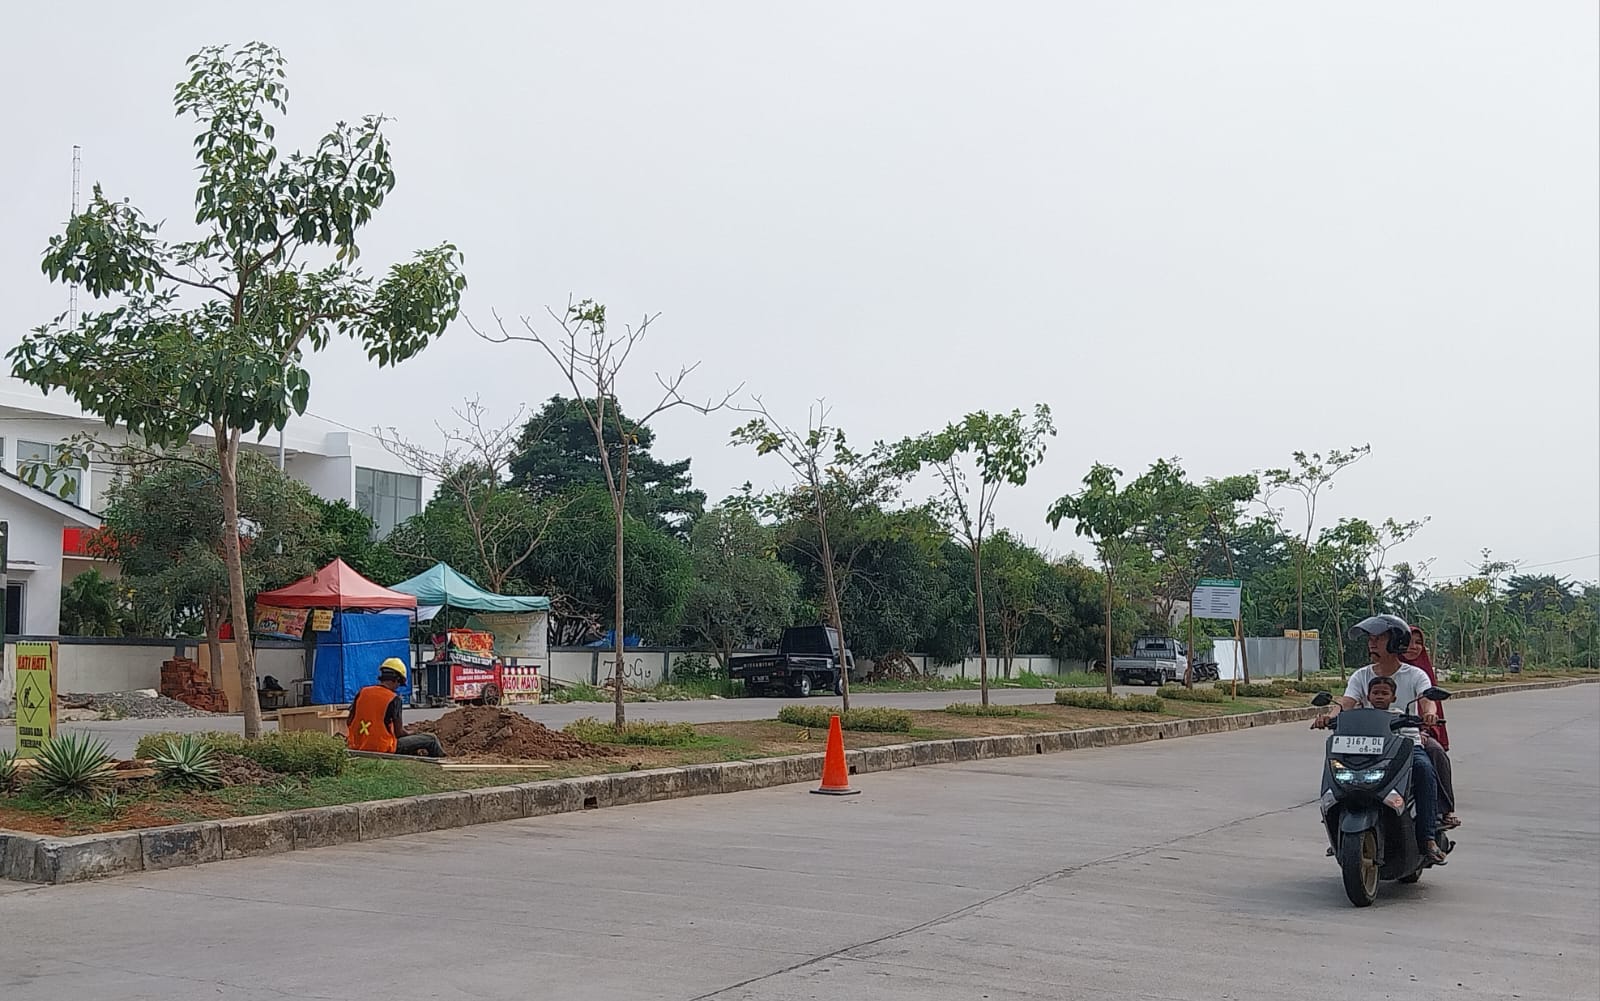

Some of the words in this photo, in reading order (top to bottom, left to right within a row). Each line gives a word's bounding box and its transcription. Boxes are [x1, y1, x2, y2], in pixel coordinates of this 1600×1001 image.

[31, 656, 47, 670] HATI
[521, 676, 538, 689] MAYO
[1334, 737, 1340, 745] A
[1346, 737, 1366, 745] 3167
[1372, 738, 1382, 746] DL
